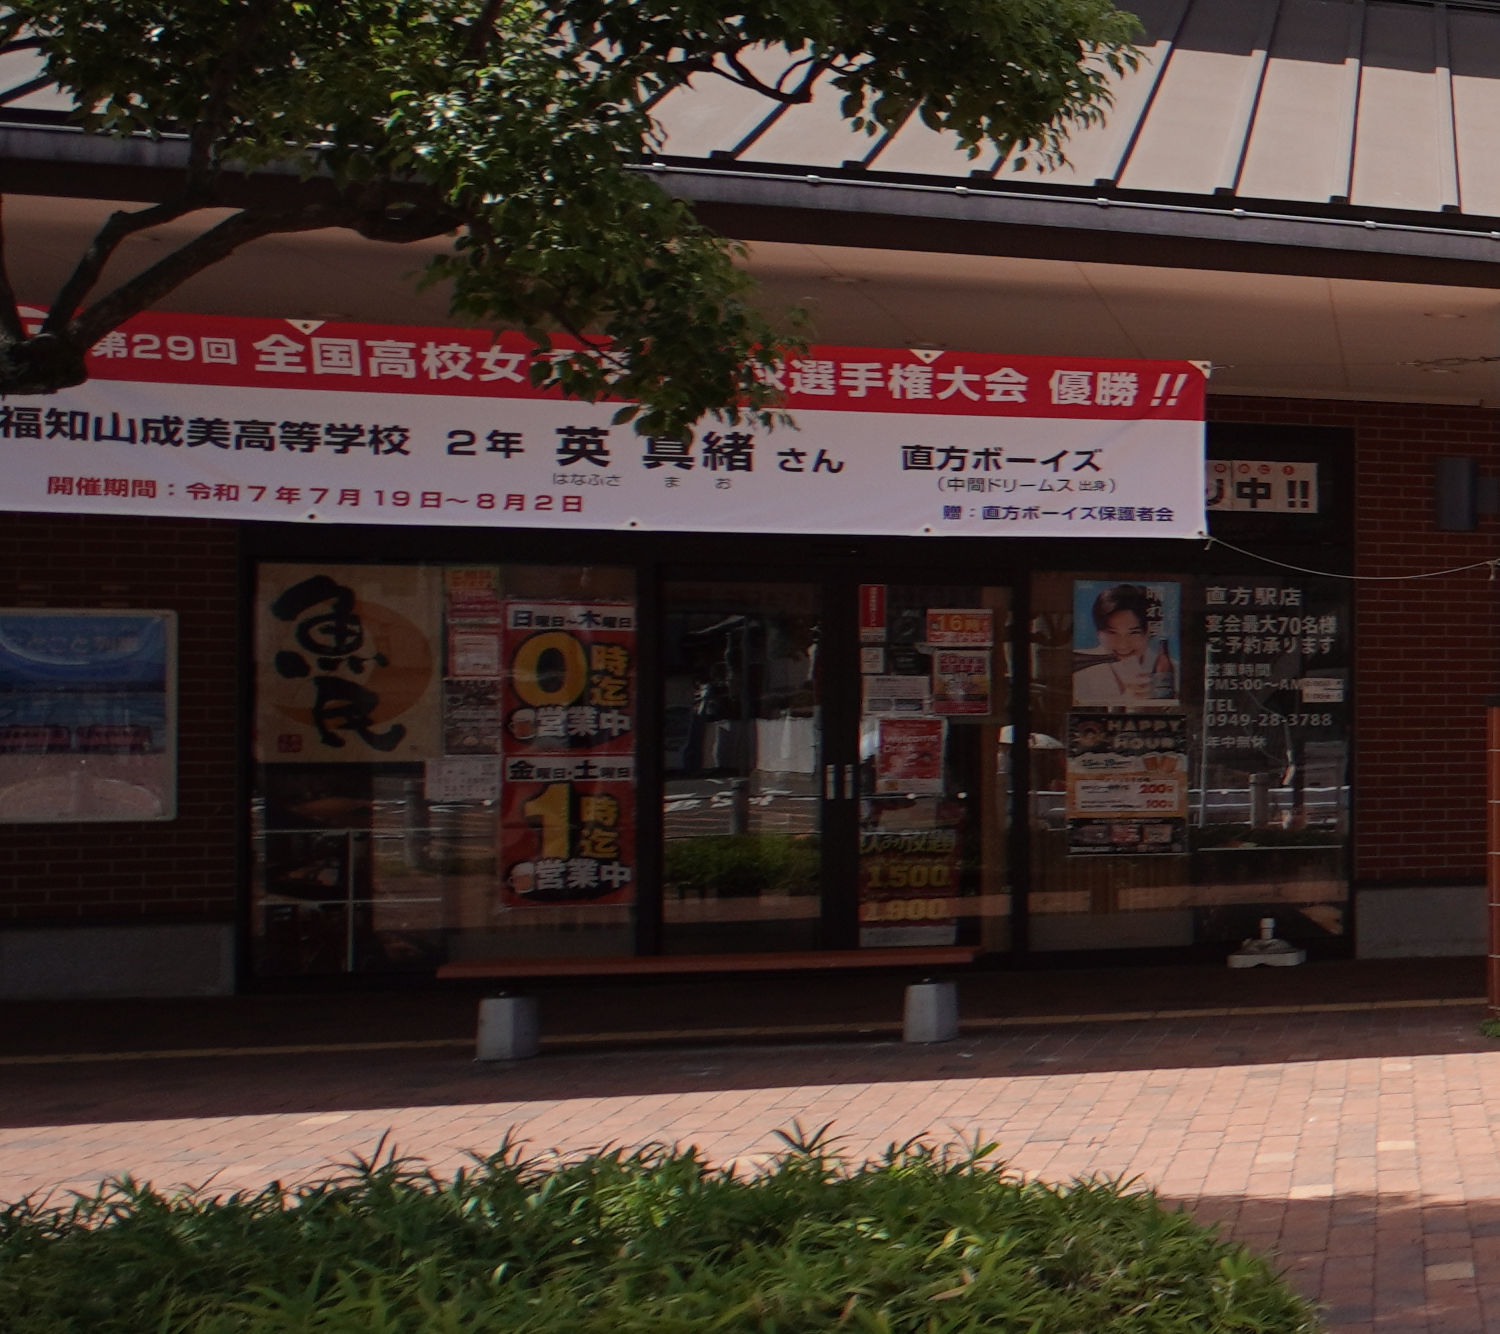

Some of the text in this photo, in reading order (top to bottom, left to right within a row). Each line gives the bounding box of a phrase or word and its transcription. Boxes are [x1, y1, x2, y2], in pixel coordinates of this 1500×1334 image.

[91, 331, 238, 365] 第29回
[0, 406, 410, 454] 福知山成美高等学校
[446, 429, 524, 458] 2年
[556, 425, 611, 468] 英
[776, 447, 845, 474] さん
[901, 444, 1103, 472] 直方ボーイズ
[1205, 586, 1302, 607] 直方駅店
[1204, 613, 1338, 636] 宴会最大70名様
[1209, 636, 1336, 655] ご予約承ります
[1206, 699, 1238, 713] TEL
[1206, 713, 1333, 727] 0949-28-3788
